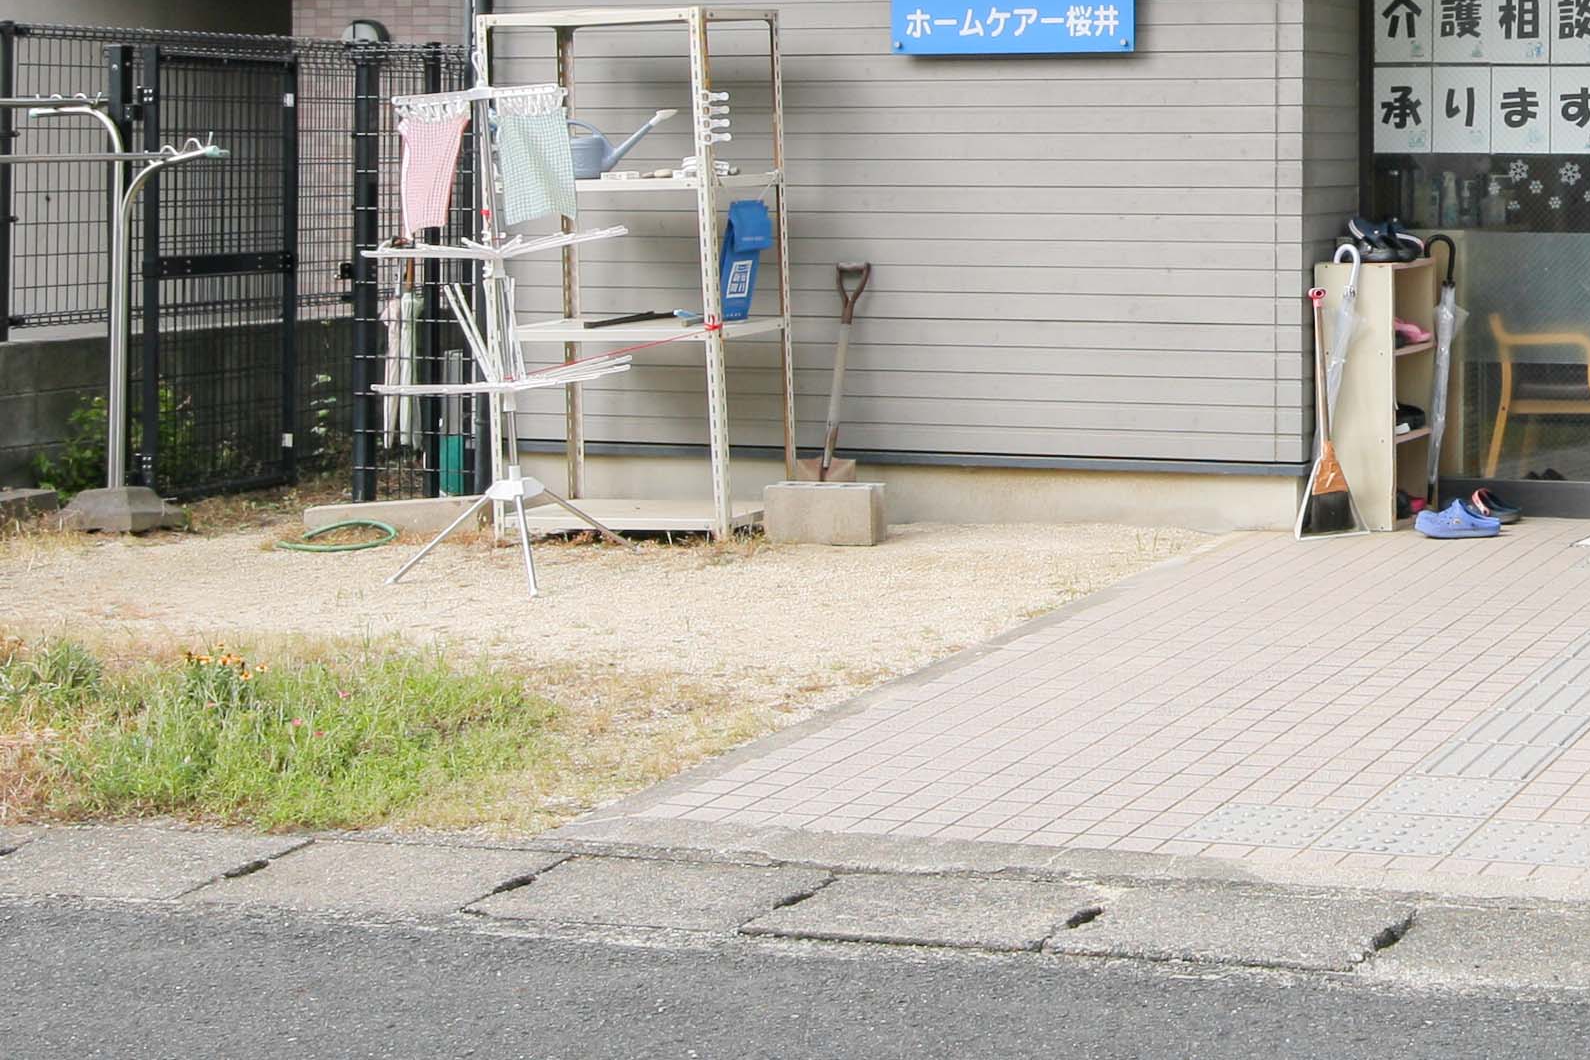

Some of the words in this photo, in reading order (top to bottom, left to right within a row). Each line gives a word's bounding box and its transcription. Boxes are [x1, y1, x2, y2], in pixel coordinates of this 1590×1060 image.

[905, 5, 1119, 38] ホームケアー桜井
